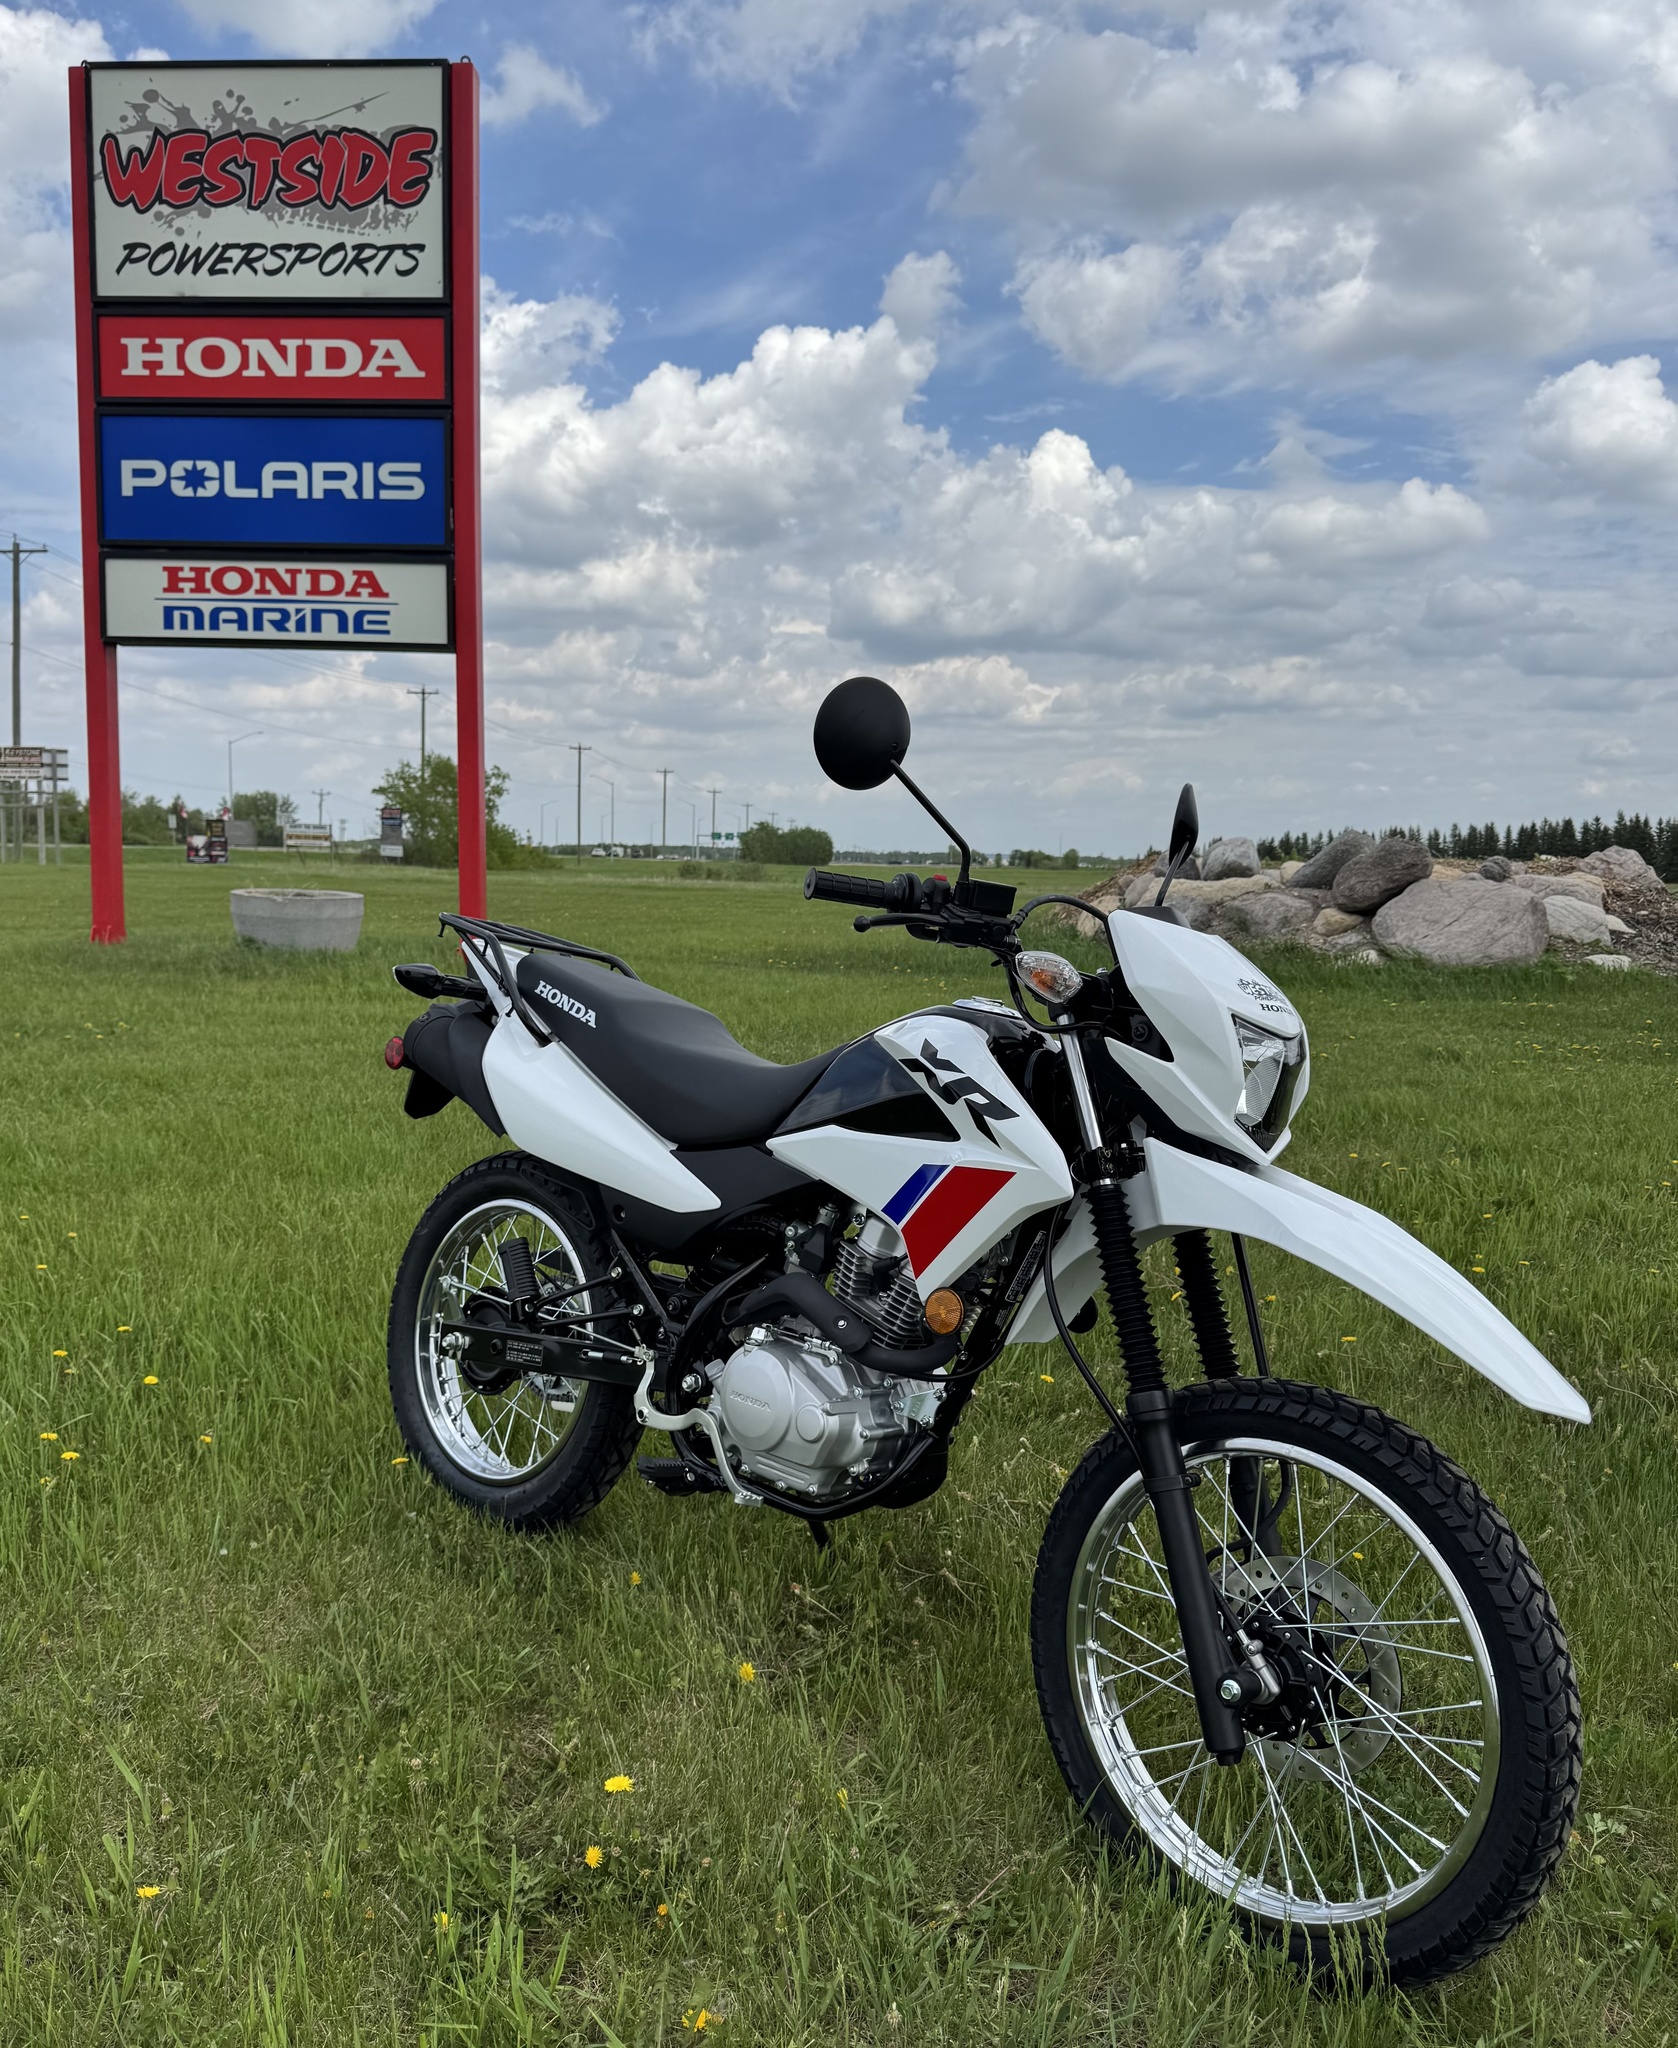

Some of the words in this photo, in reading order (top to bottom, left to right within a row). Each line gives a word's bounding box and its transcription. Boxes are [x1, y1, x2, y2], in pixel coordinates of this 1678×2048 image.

[101, 127, 438, 214] WESTSIDE
[115, 242, 426, 277] POWERSPORTS
[120, 337, 426, 378] HONDA
[120, 459, 425, 500] POLARIS
[162, 566, 390, 598] HONDA
[163, 605, 391, 635] MARINE
[534, 980, 597, 1029] HONDA
[1259, 1003, 1294, 1015] HON
[730, 1390, 772, 1412] HONDA
